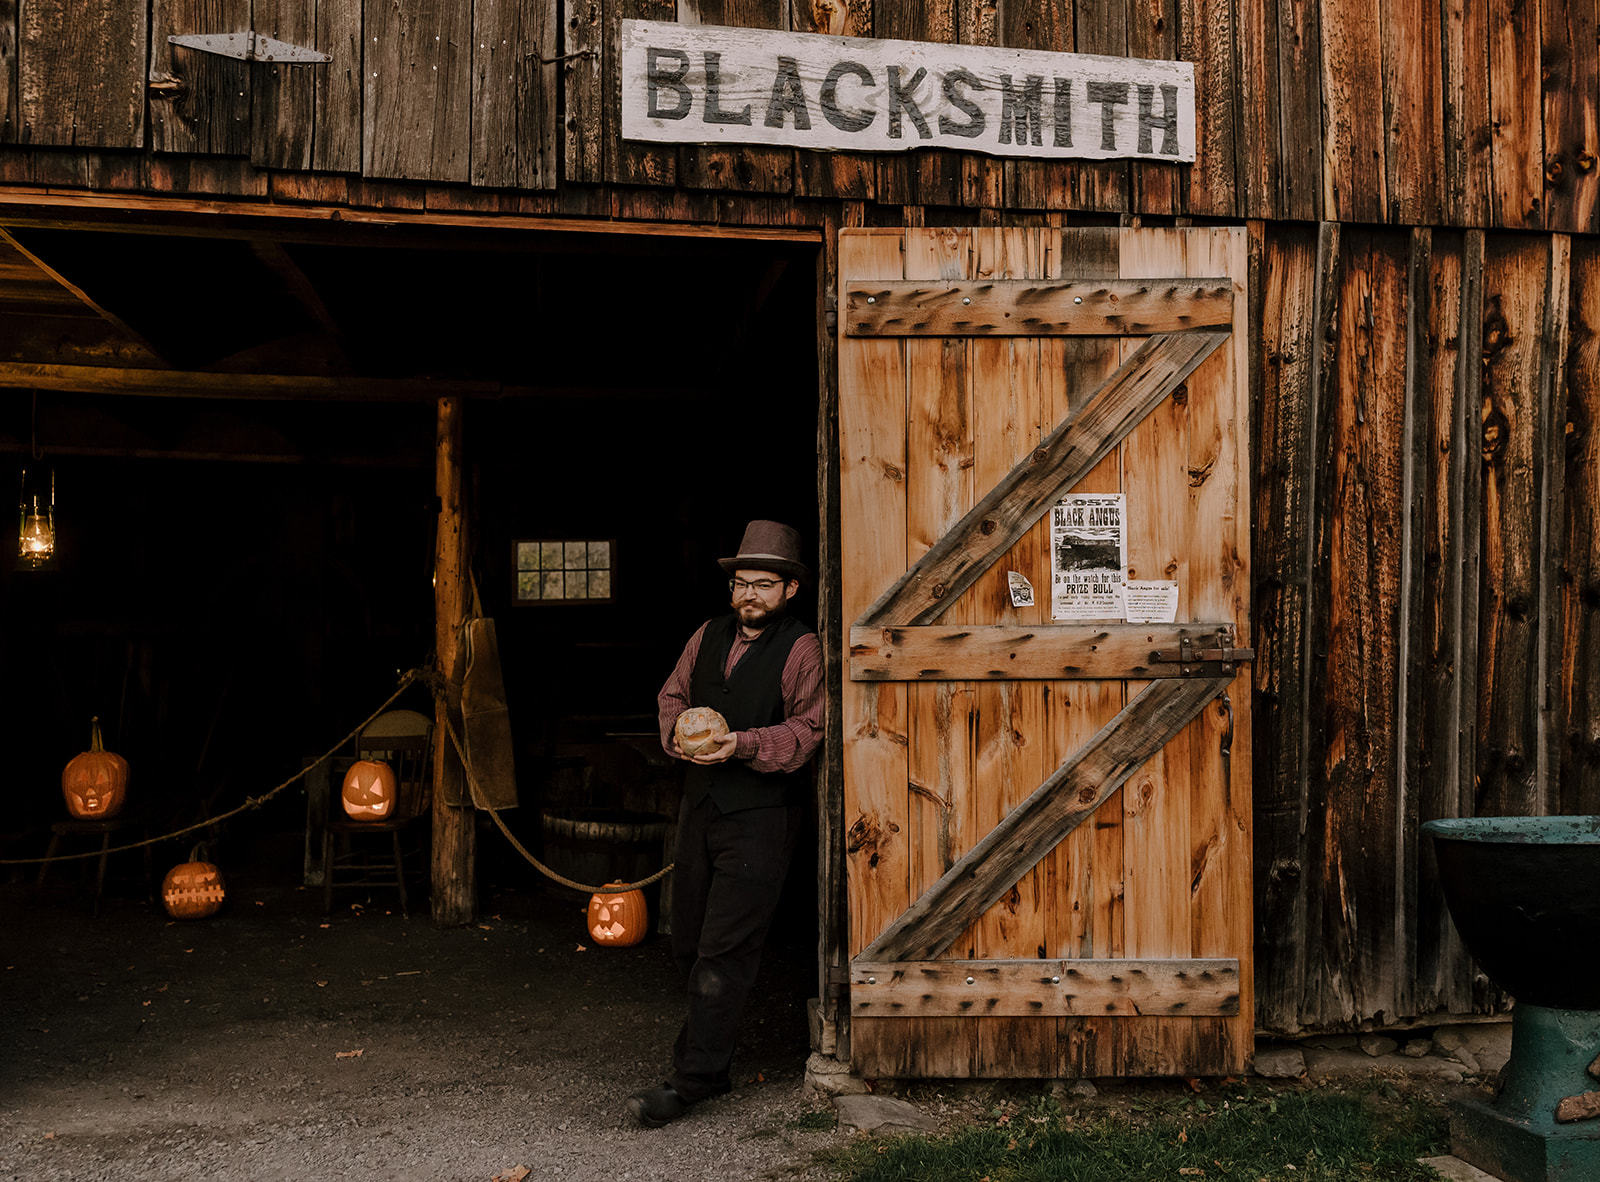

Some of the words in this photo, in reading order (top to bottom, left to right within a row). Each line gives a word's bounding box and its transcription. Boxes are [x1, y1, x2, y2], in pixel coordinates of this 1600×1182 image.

[646, 47, 1180, 155] BLACKSMITH
[1055, 507, 1084, 526] BLACK
[1089, 507, 1120, 526] ANGUS
[1055, 574, 1061, 584] Be
[1063, 575, 1070, 583] on
[1072, 574, 1081, 583] the
[1083, 574, 1099, 583] watch
[1102, 573, 1110, 583] for
[1111, 573, 1121, 583] this
[1066, 584, 1089, 594] PRIZE
[1093, 584, 1113, 594] BULL
